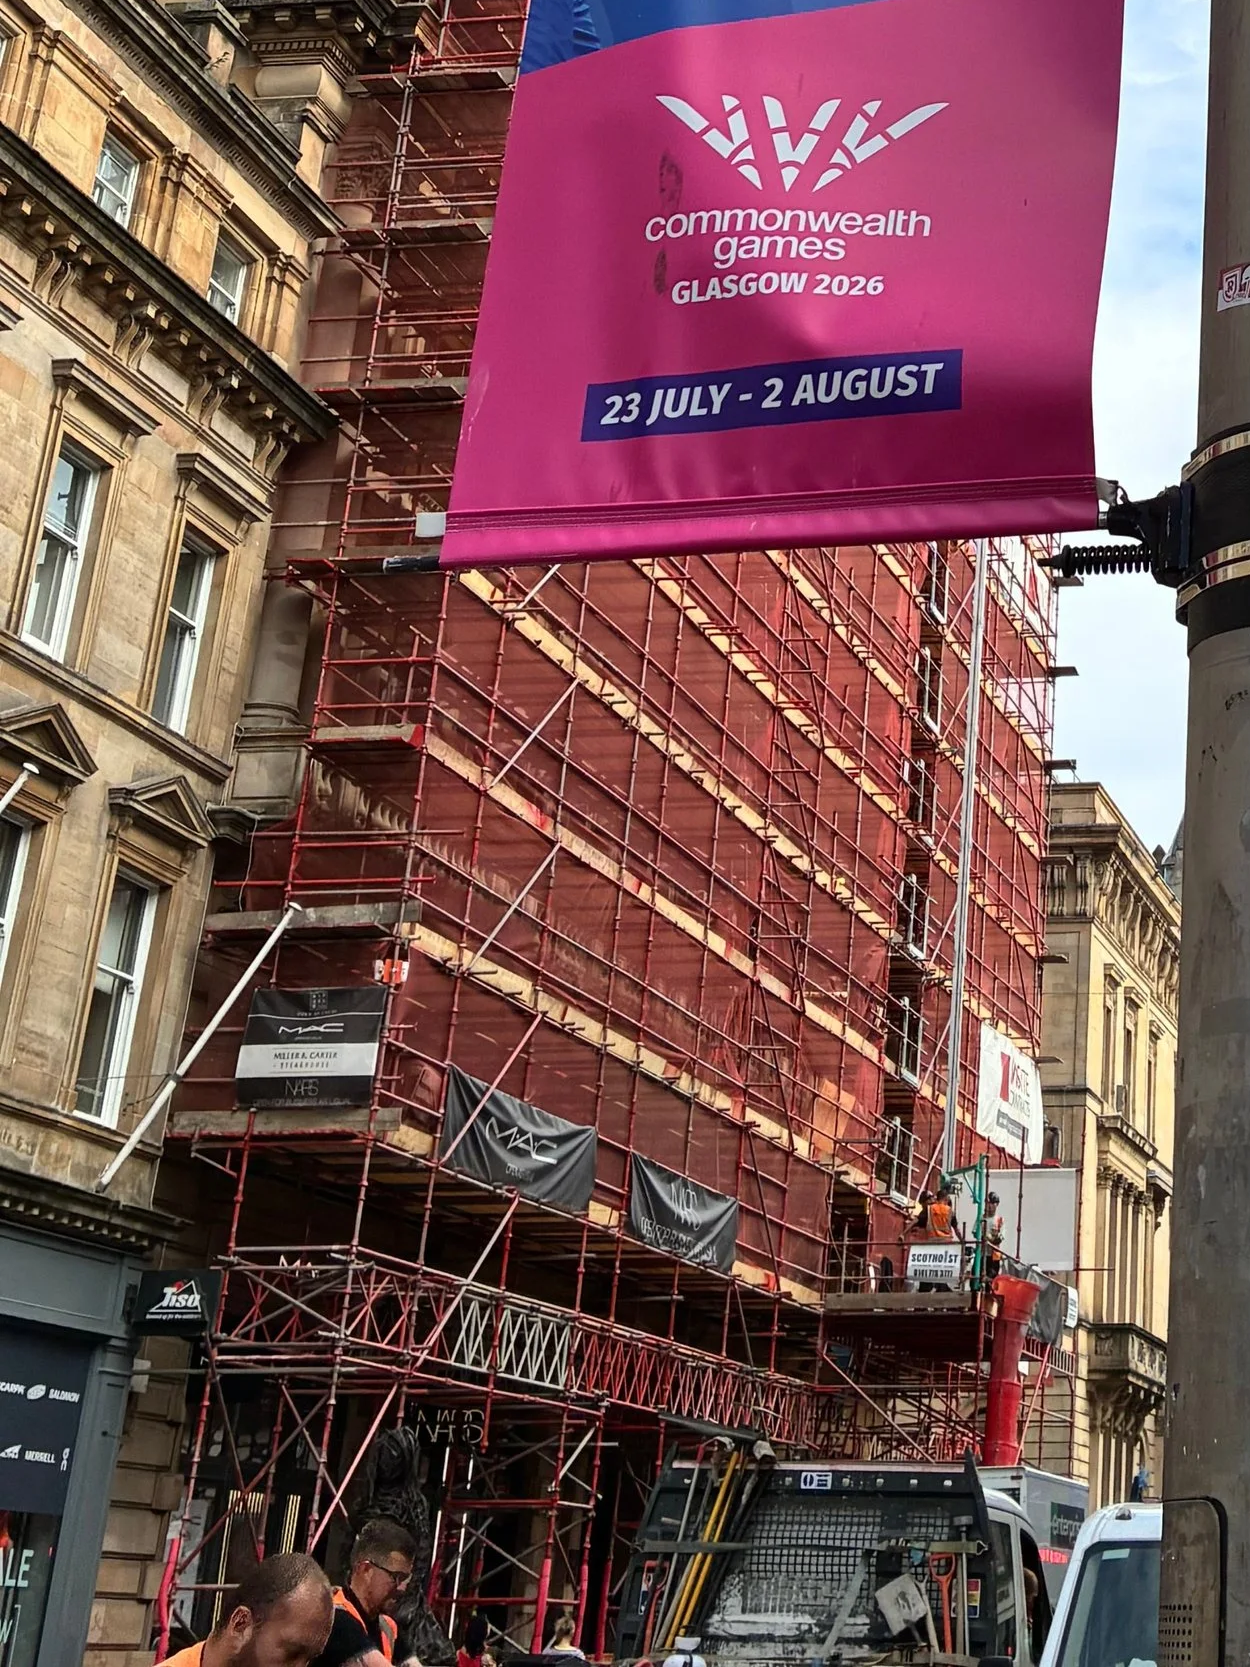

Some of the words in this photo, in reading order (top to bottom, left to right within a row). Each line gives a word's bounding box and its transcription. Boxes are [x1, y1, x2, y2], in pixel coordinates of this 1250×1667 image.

[644, 208, 932, 243] commonwealth
[713, 233, 847, 270] games
[671, 271, 808, 306] GLASGOW
[812, 273, 885, 296] 2026
[600, 392, 641, 426] 23
[646, 382, 734, 427] JULY
[761, 376, 783, 410] 2
[791, 362, 945, 407] AUGUST
